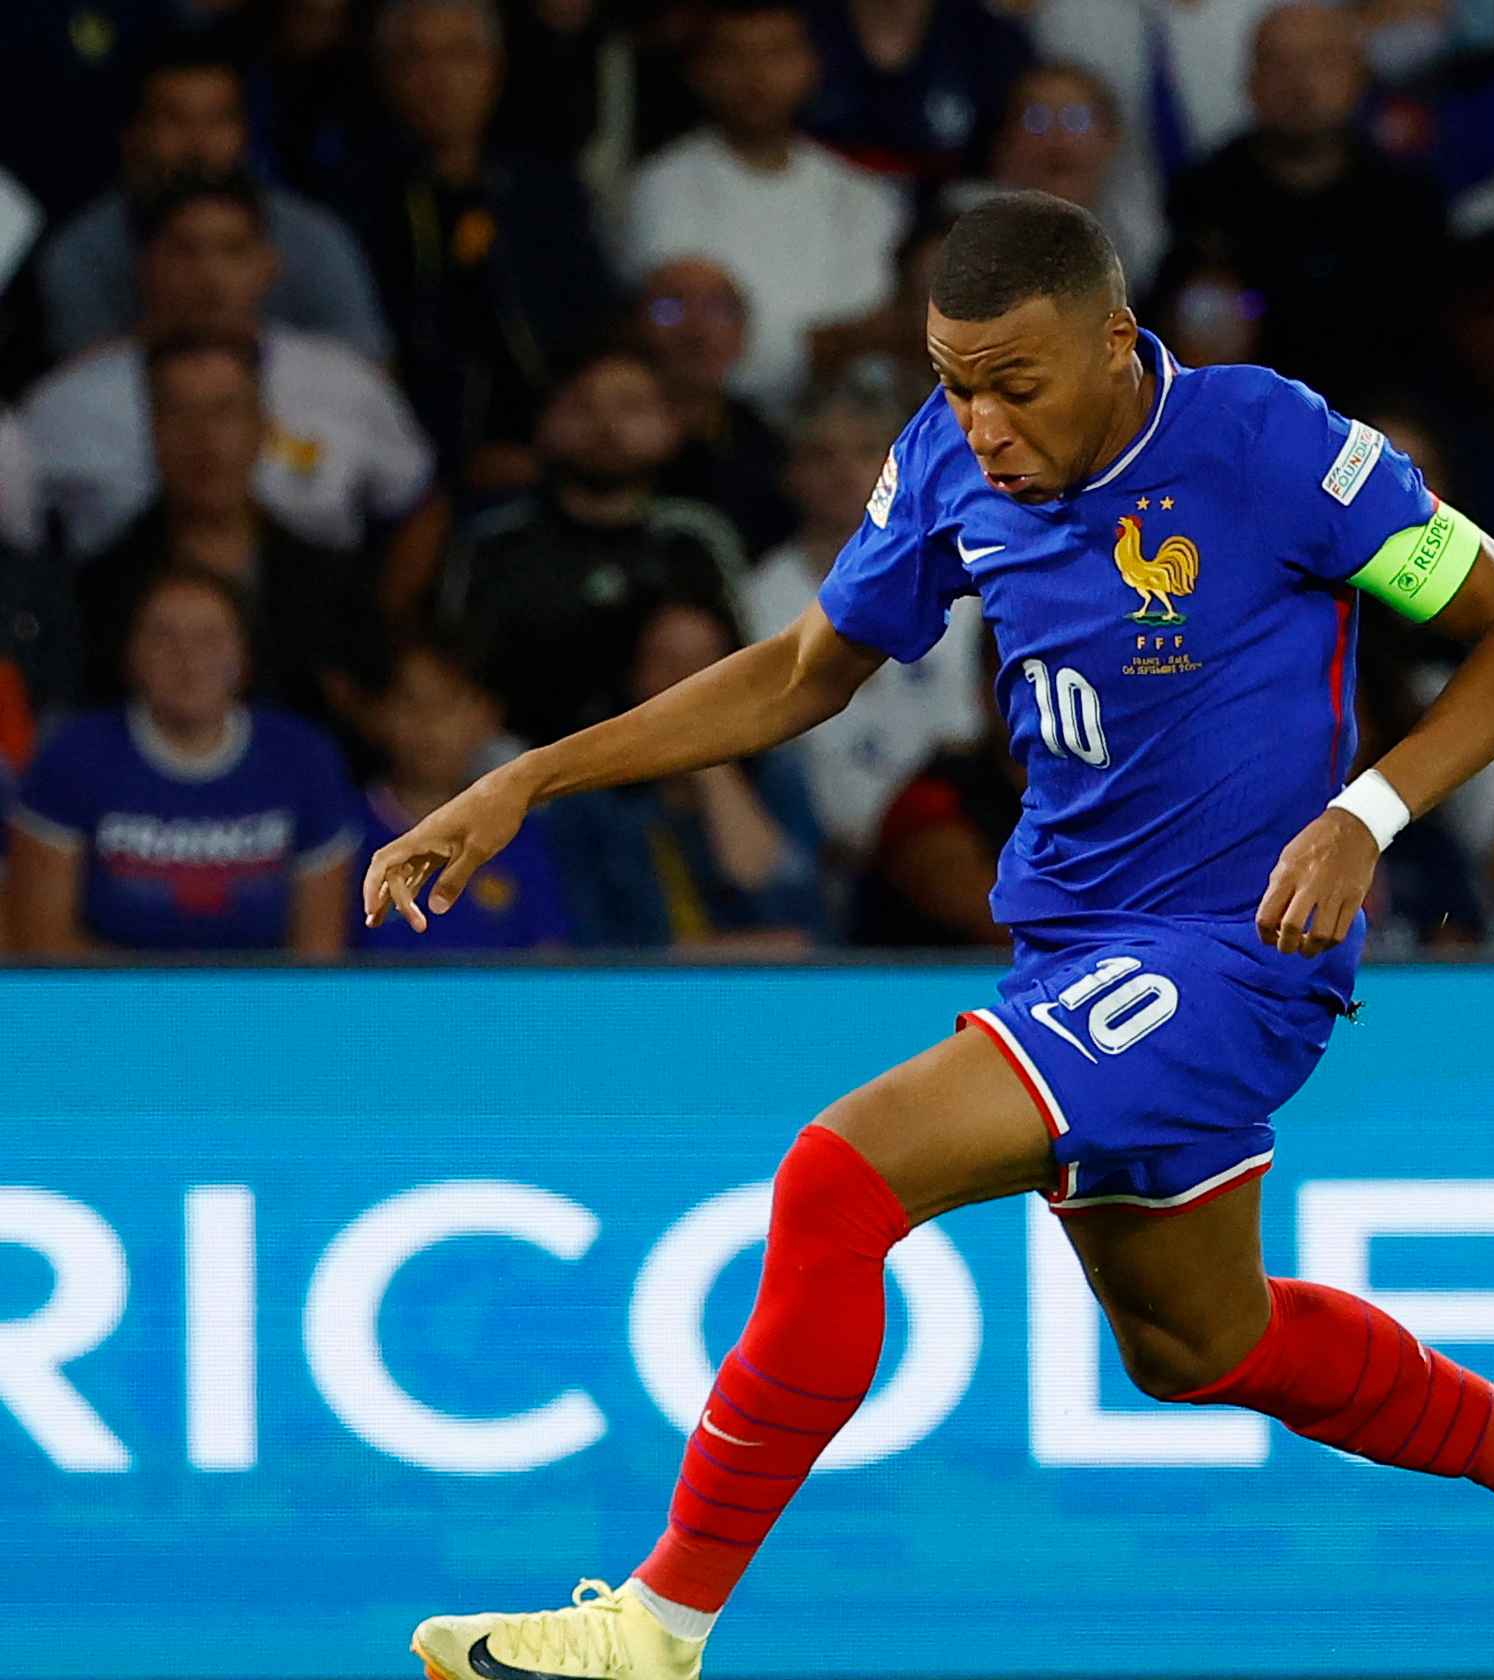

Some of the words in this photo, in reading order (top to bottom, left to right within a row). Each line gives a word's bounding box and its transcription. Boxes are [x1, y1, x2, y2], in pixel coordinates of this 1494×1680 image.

[1414, 513, 1449, 570] RESPEC
[1022, 658, 1111, 769] 10
[1058, 956, 1178, 1055] 10
